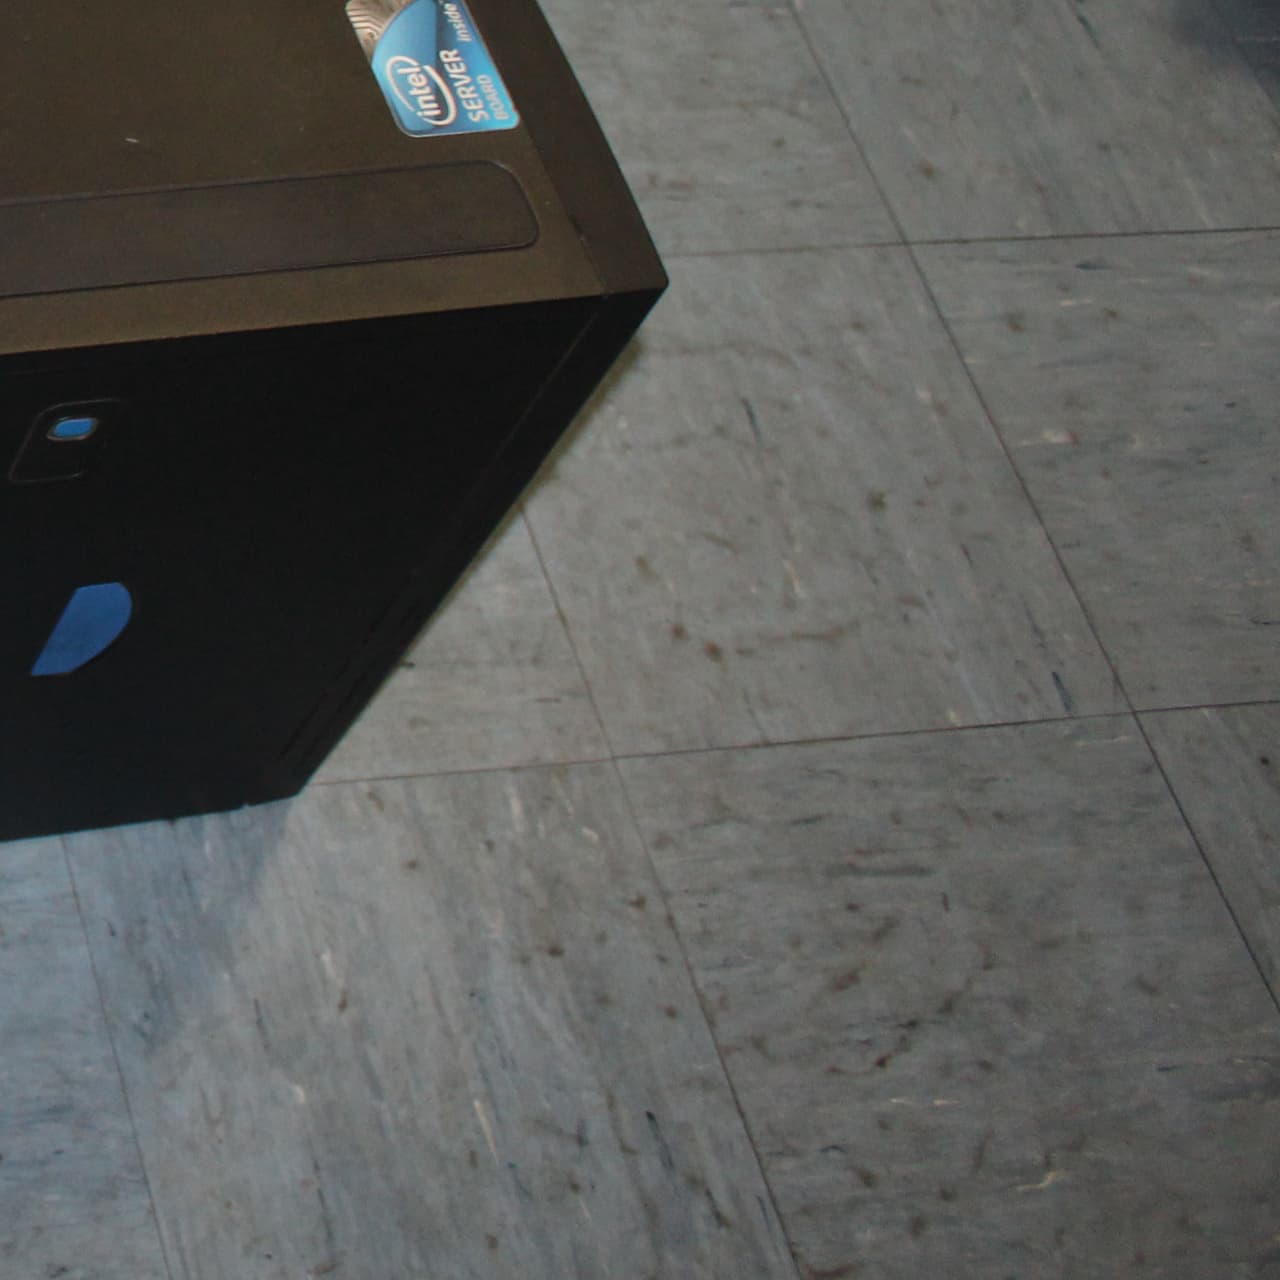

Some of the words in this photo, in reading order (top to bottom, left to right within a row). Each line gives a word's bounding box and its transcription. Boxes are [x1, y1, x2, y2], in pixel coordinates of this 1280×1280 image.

[444, 2, 472, 42] inside
[397, 65, 441, 117] intel
[440, 49, 489, 123] SERVER
[477, 74, 509, 121] BOARD
